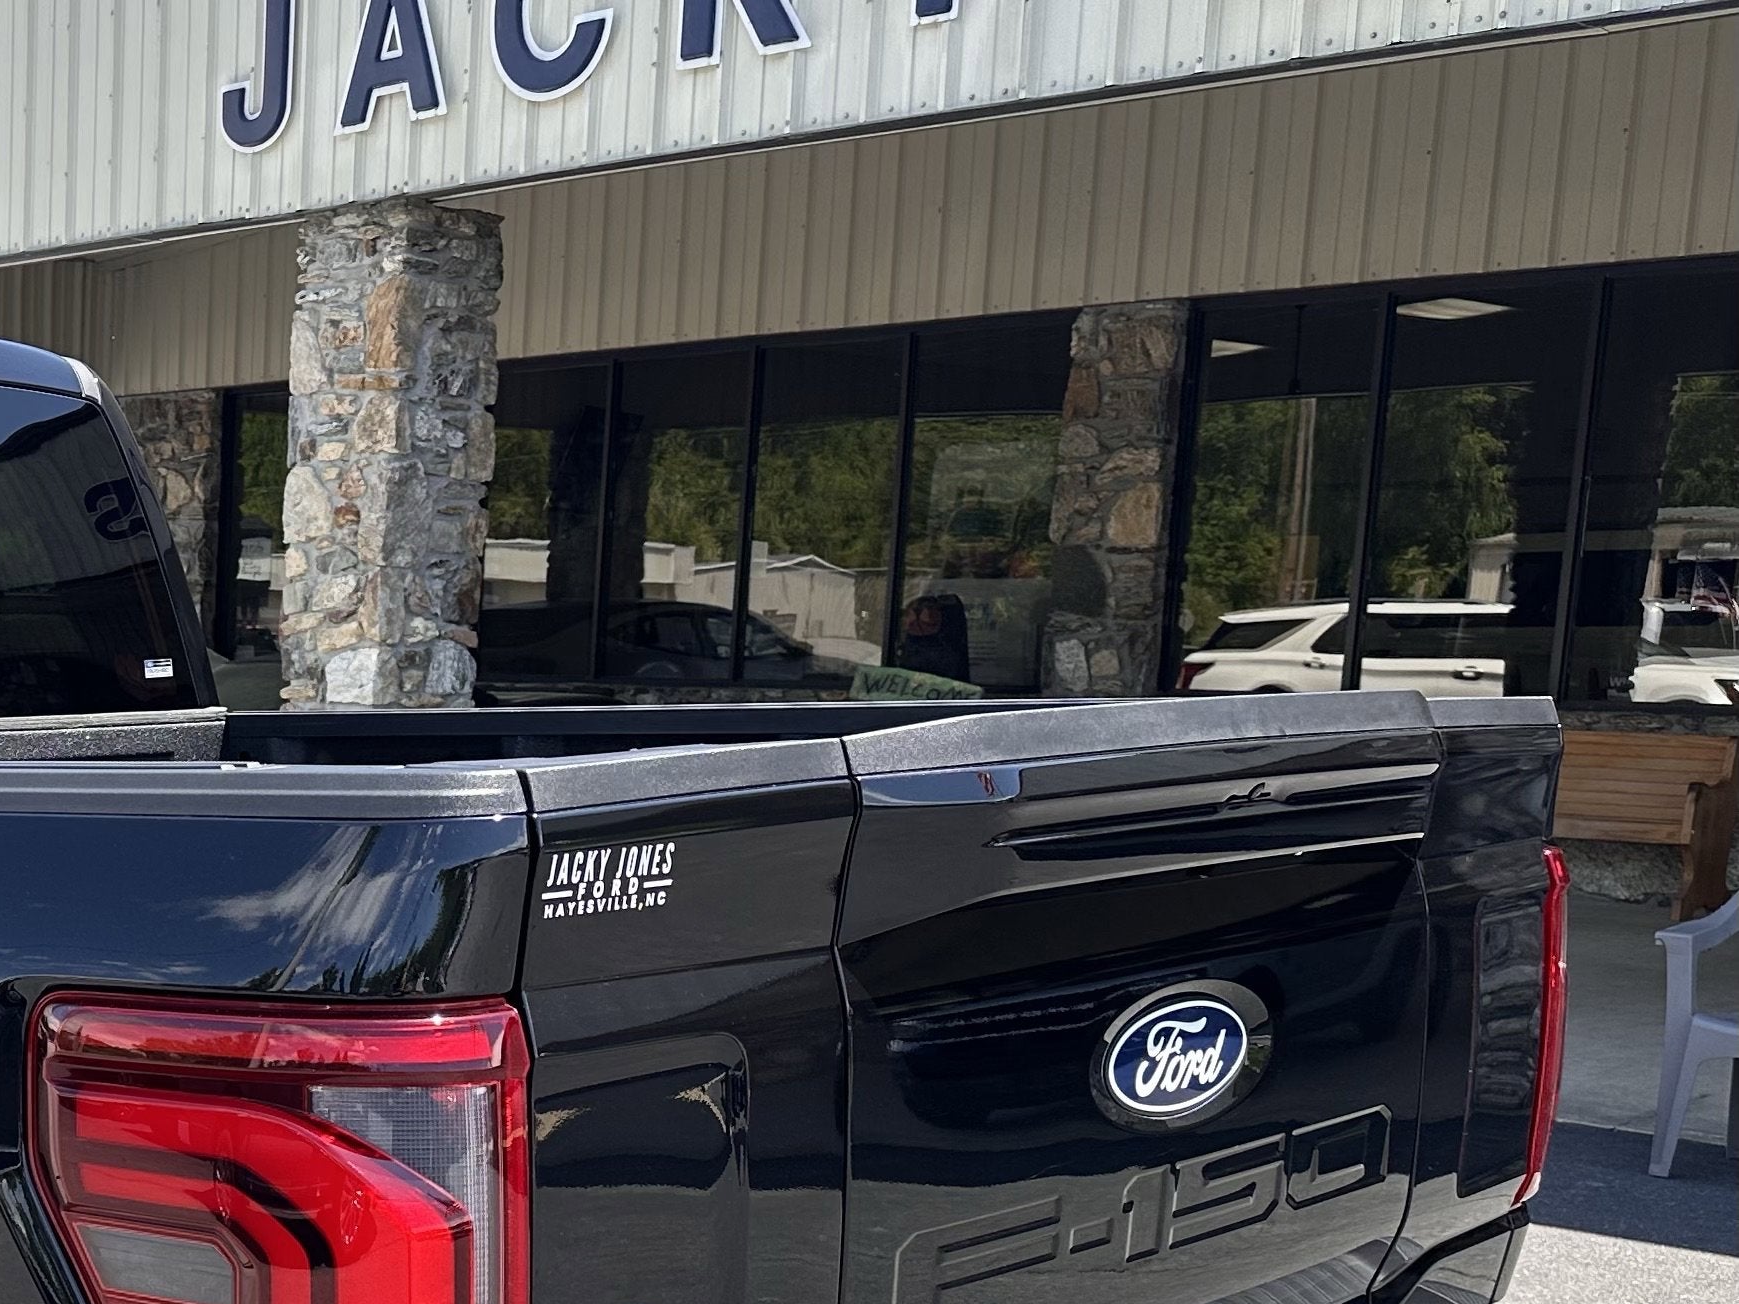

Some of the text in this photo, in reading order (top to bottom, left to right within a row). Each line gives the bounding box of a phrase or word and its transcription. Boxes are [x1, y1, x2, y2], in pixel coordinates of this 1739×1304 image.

[546, 842, 676, 888] JACKY JONES
[577, 877, 639, 901] FORD
[1135, 1016, 1227, 1098] Ford
